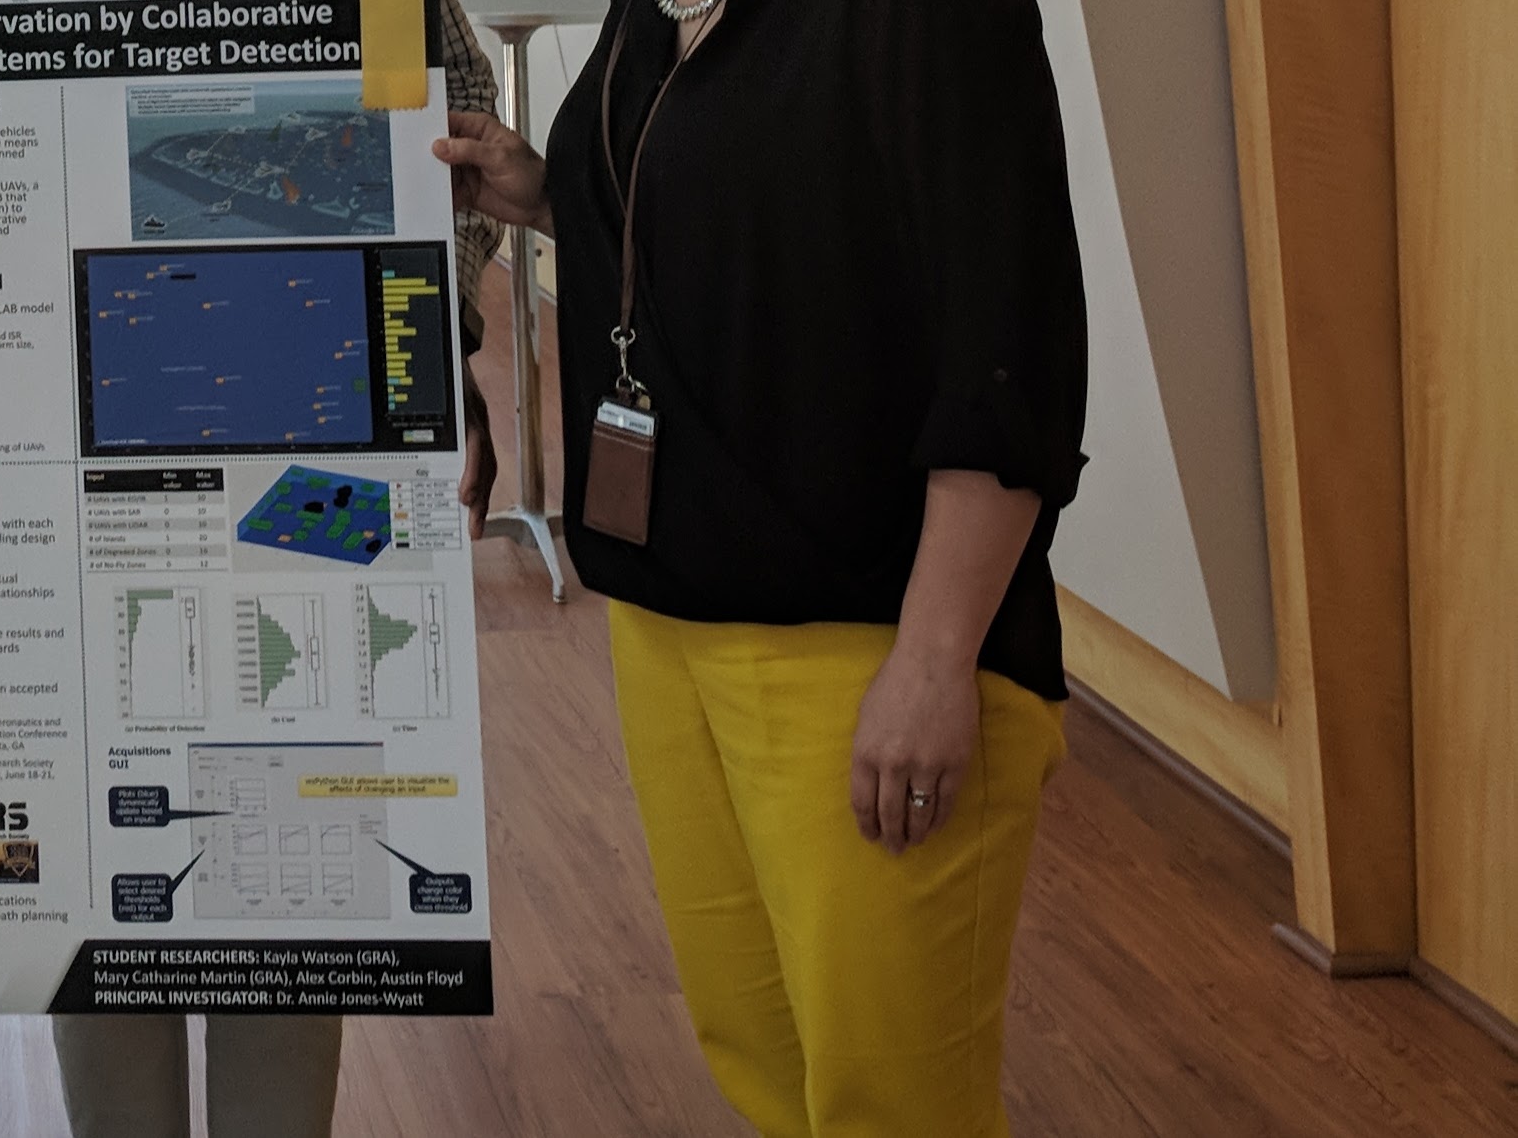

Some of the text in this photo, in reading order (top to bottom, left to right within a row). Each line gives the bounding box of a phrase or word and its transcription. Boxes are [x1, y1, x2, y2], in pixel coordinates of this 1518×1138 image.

[100, 6, 133, 36] by
[142, 0, 333, 29] Collaborative
[73, 45, 114, 70] for
[127, 42, 210, 74] Target
[220, 38, 360, 66] Detection
[0, 180, 29, 192] UAVs,
[32, 182, 38, 190] a
[5, 191, 27, 202] that
[11, 202, 22, 212] to
[20, 302, 54, 313] model
[1, 518, 25, 528] with
[28, 518, 54, 528] each
[108, 746, 171, 758] Acquisitions
[108, 759, 130, 770] GUI
[93, 950, 400, 967] STUDENT RESEARCHERS: Kayla Watson (GRA),
[94, 971, 464, 988] Mary Catharine Martin (GRA), Alex Corbin, Austin Floyd
[94, 990, 424, 1008] PRINCIPAL INVESTIGATOR: Dr. Annie Jones-Wyatt
